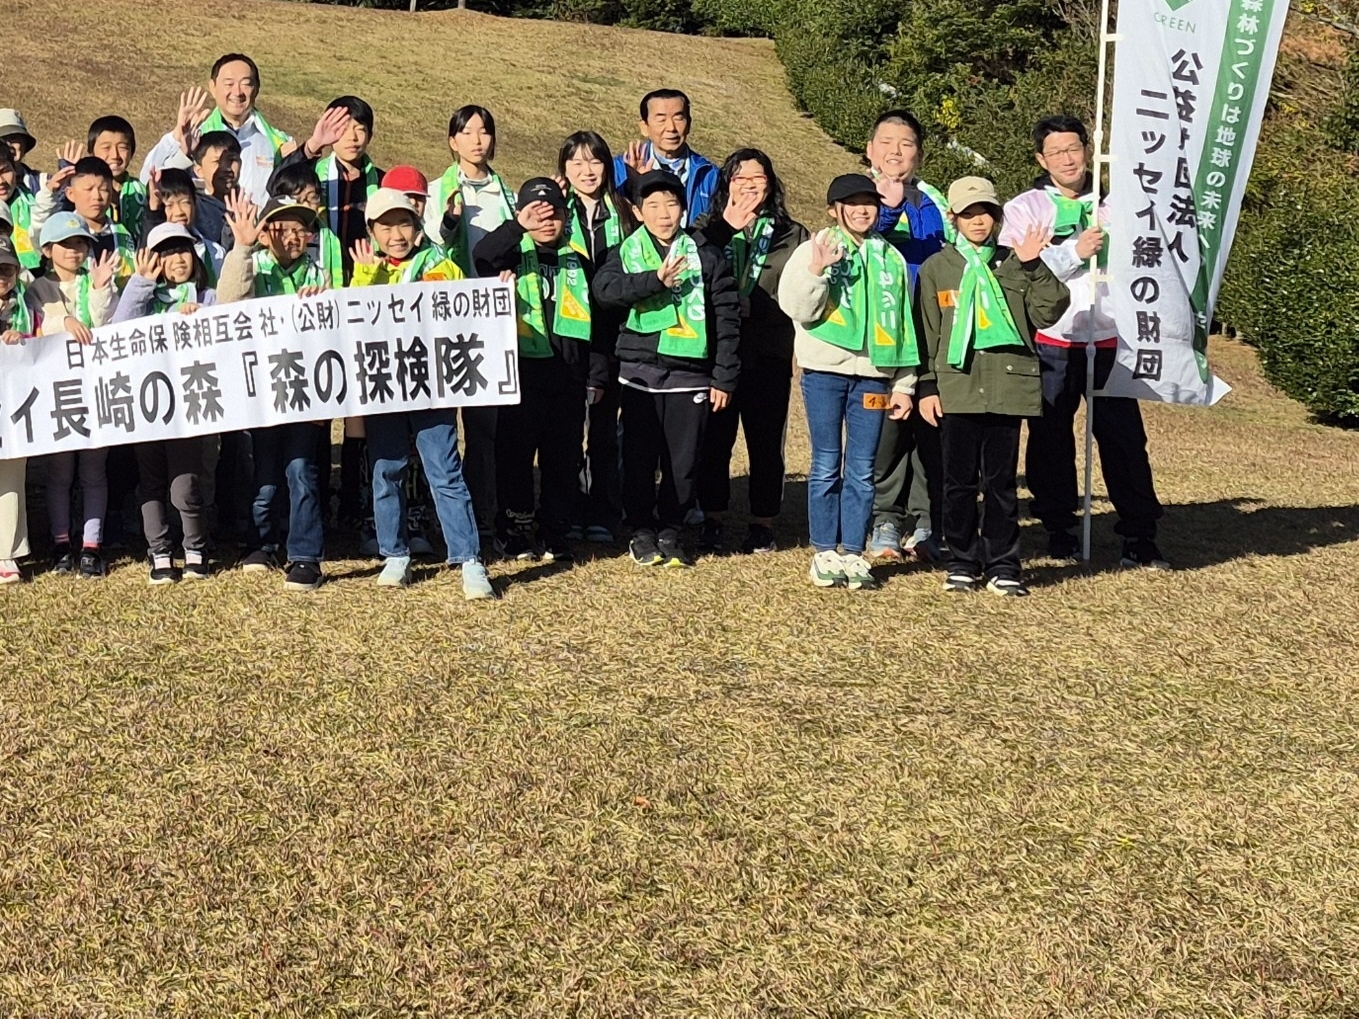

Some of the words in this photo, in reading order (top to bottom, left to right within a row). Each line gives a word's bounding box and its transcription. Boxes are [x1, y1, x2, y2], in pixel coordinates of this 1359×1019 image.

[1154, 11, 1197, 34] GREEN
[1129, 88, 1170, 382] ニッセイ緑の財団
